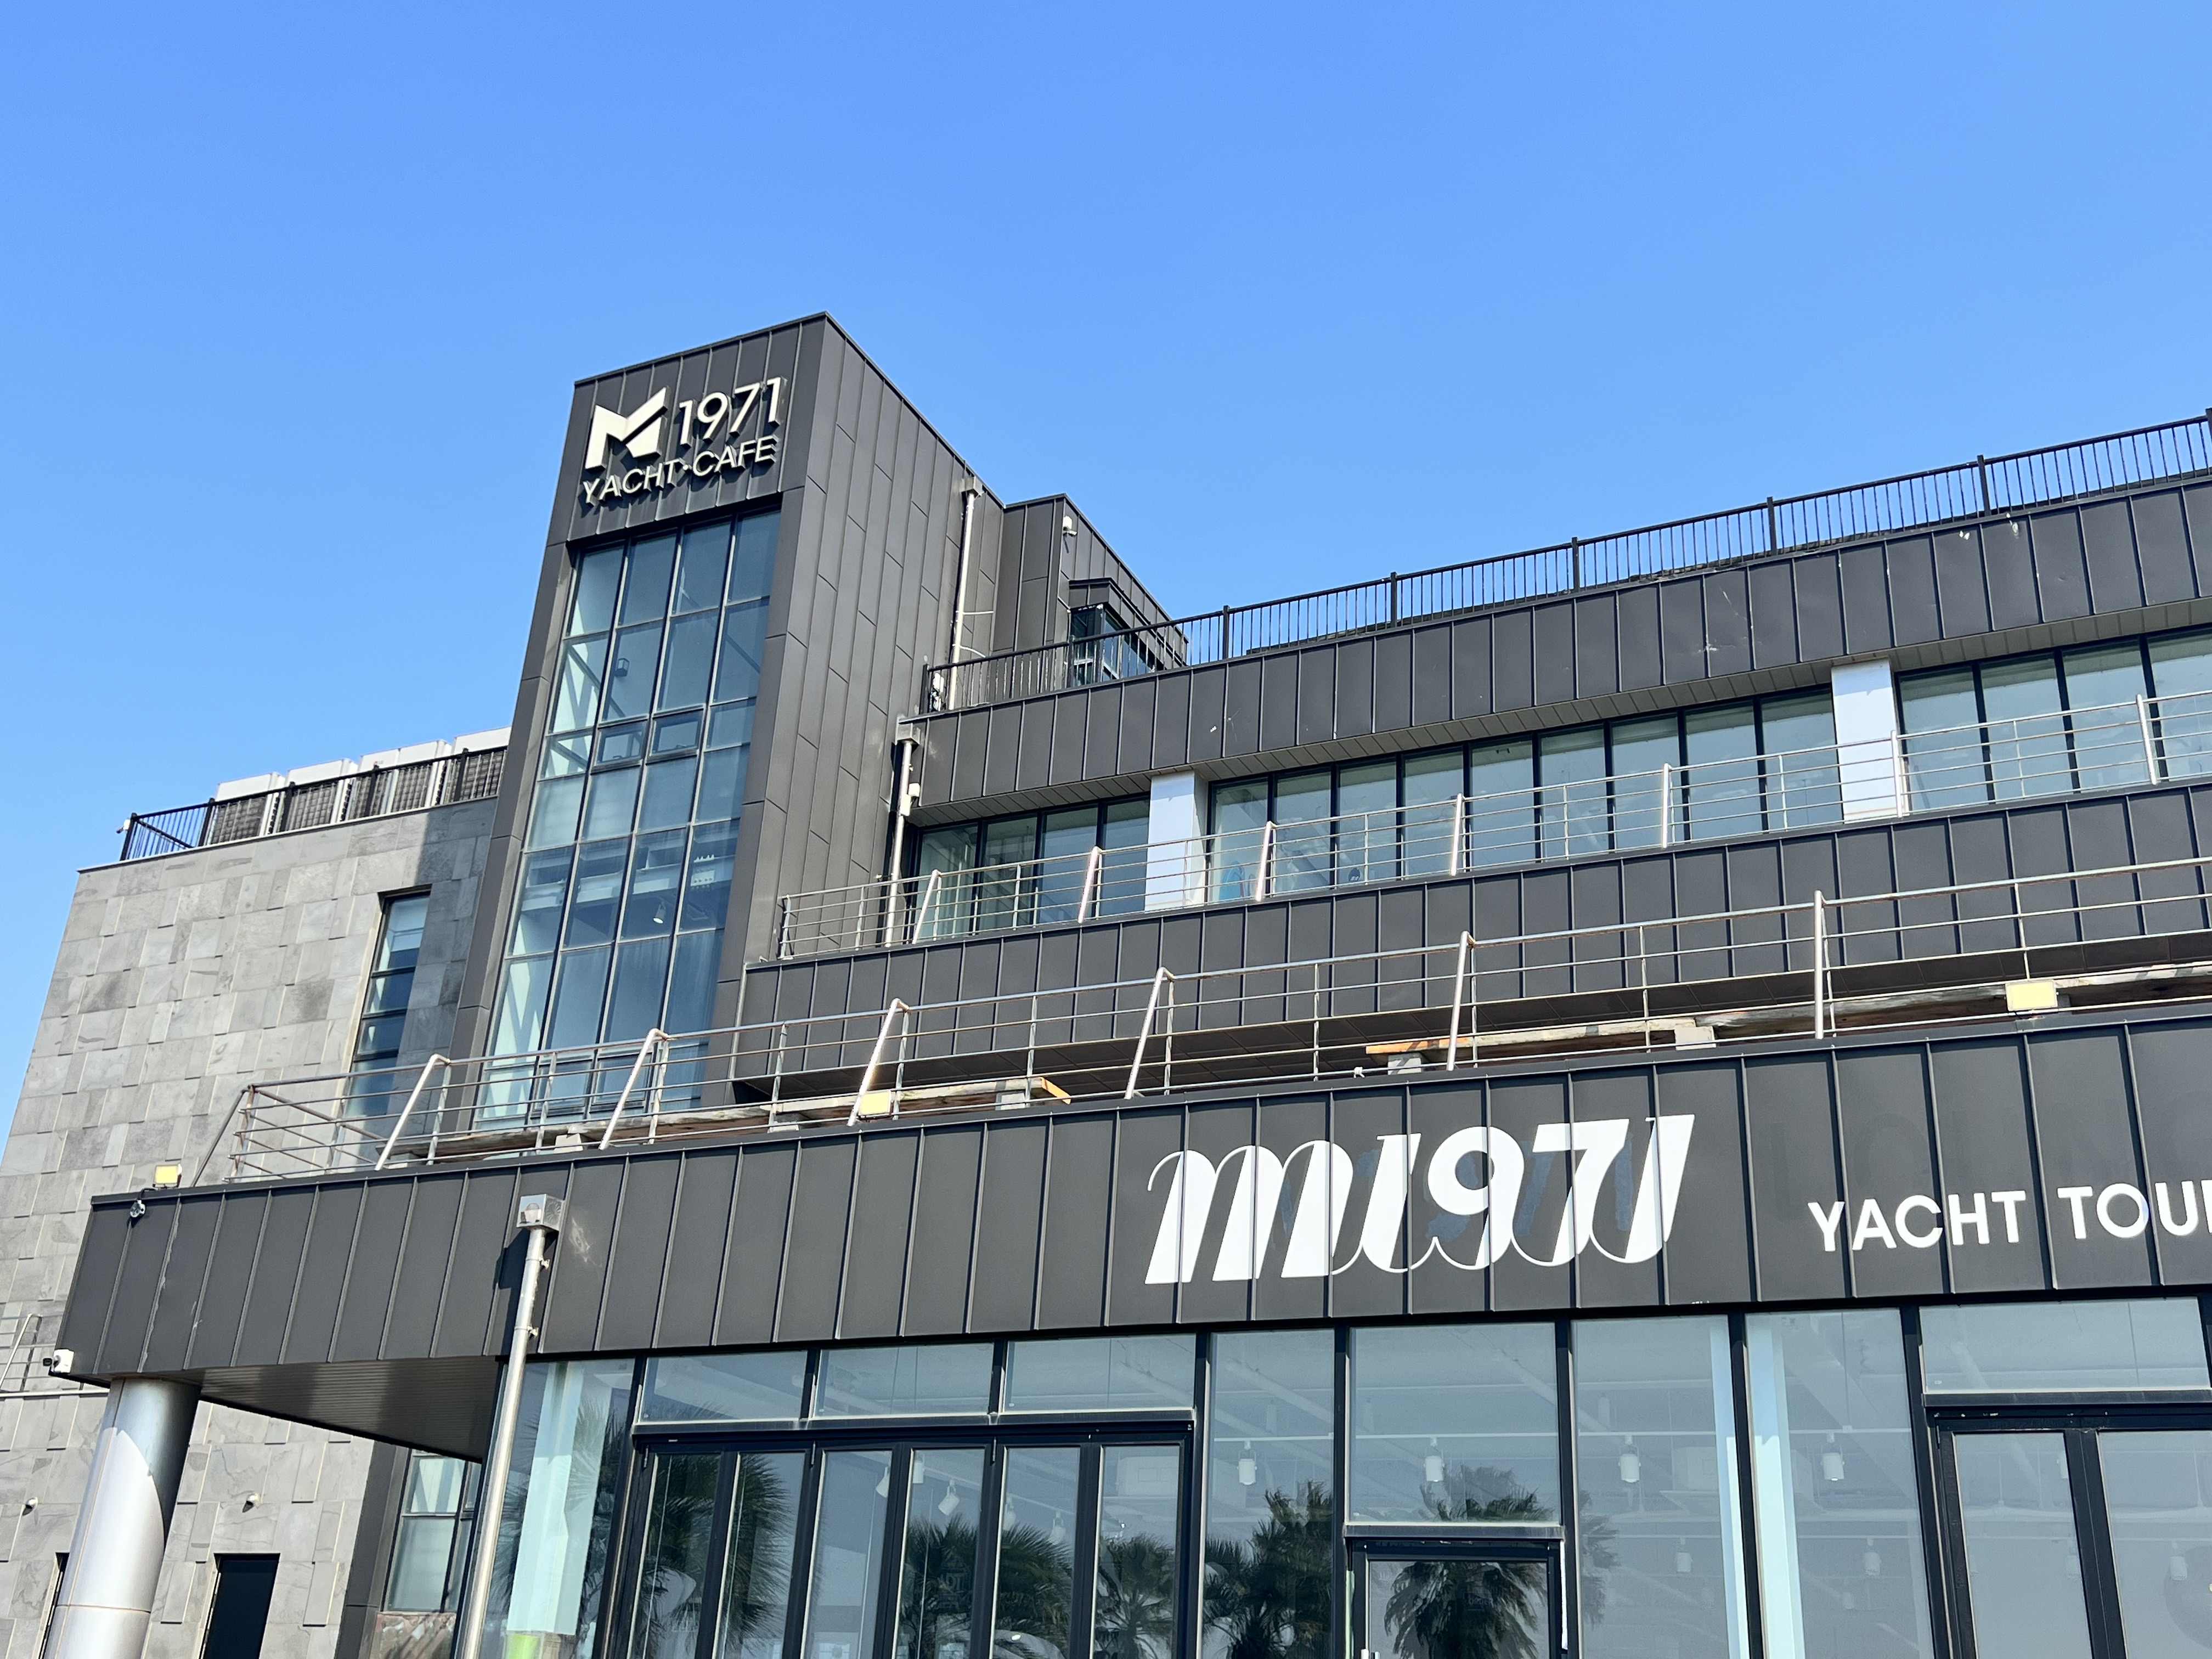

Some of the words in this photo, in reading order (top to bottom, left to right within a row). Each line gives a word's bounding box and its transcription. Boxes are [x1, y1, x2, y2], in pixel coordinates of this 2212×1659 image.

[679, 376, 787, 449] 1971
[1807, 1190, 2027, 1252] YACHT
[2057, 1180, 2212, 1240] TOU
